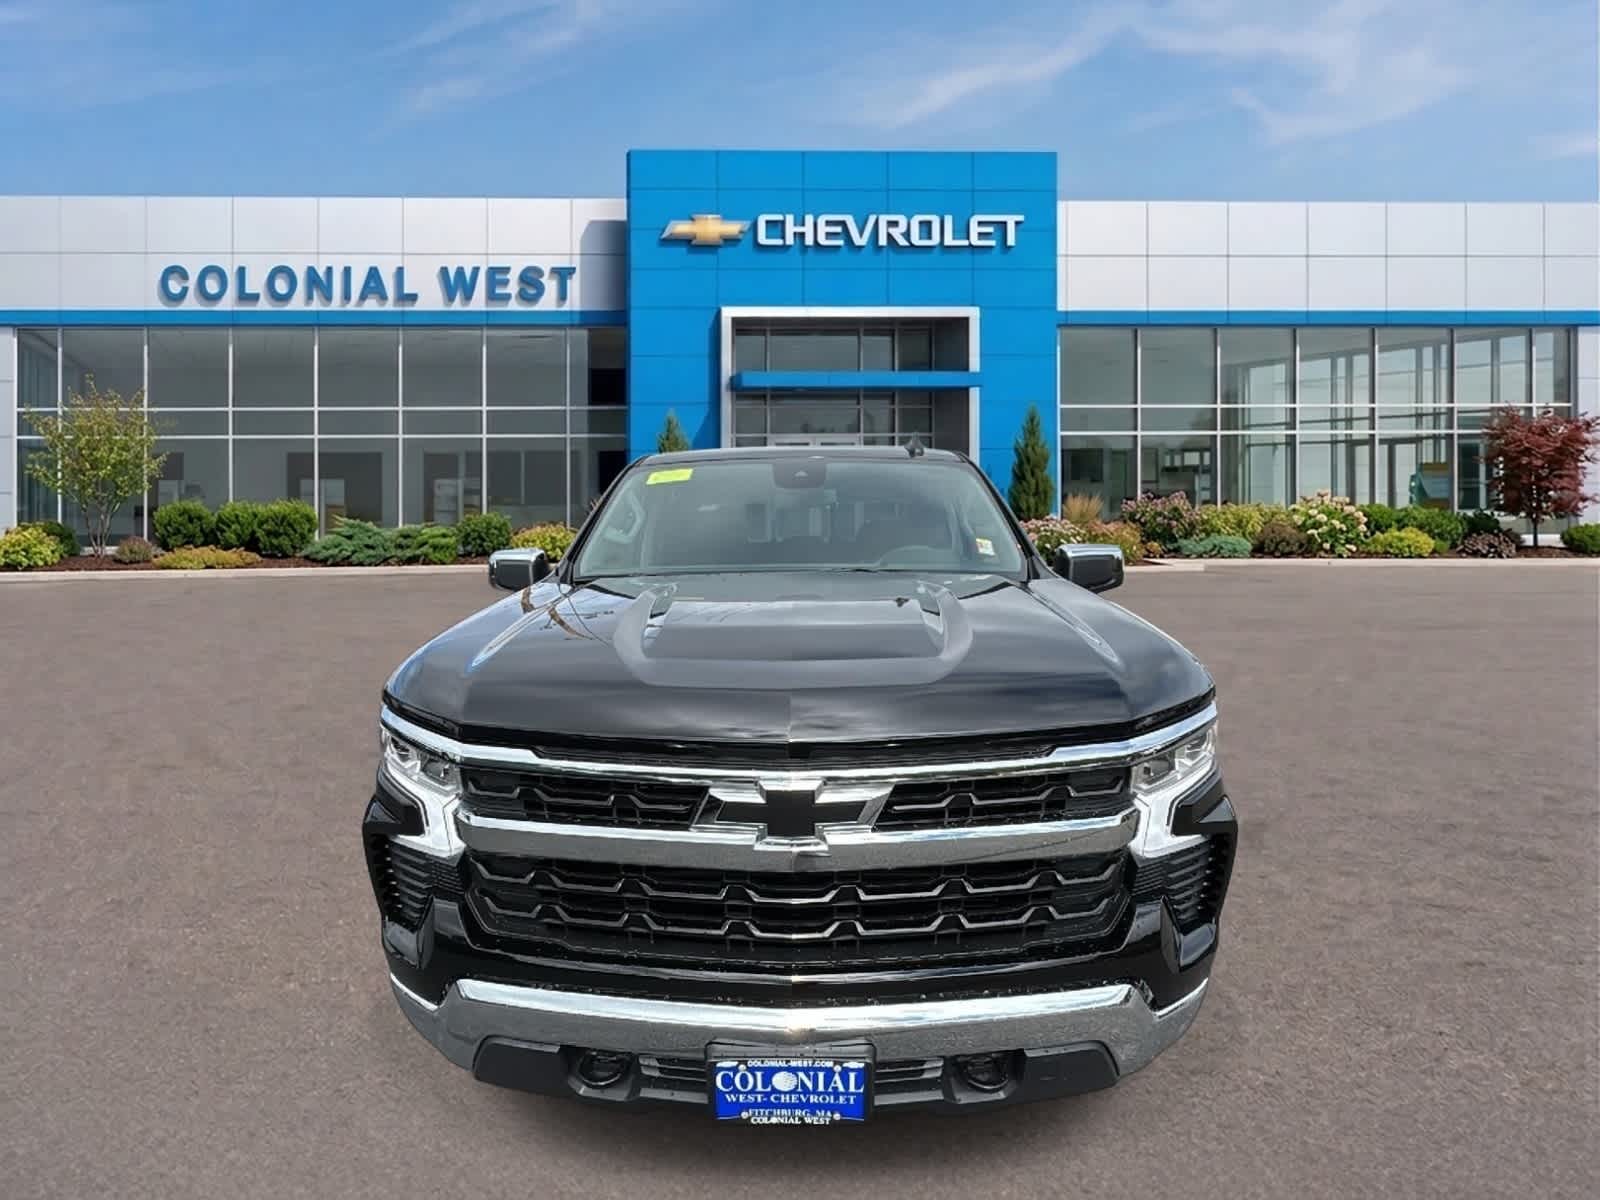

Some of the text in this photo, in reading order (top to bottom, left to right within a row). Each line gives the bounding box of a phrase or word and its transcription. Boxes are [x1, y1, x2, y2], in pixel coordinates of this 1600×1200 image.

[756, 213, 1025, 248] CHEVROLET
[159, 264, 577, 307] COLONIAL WEST
[715, 1070, 865, 1093] COLONIAL
[770, 1093, 857, 1105] CHEVROLET
[750, 1116, 831, 1125] COLONIAL WEST
